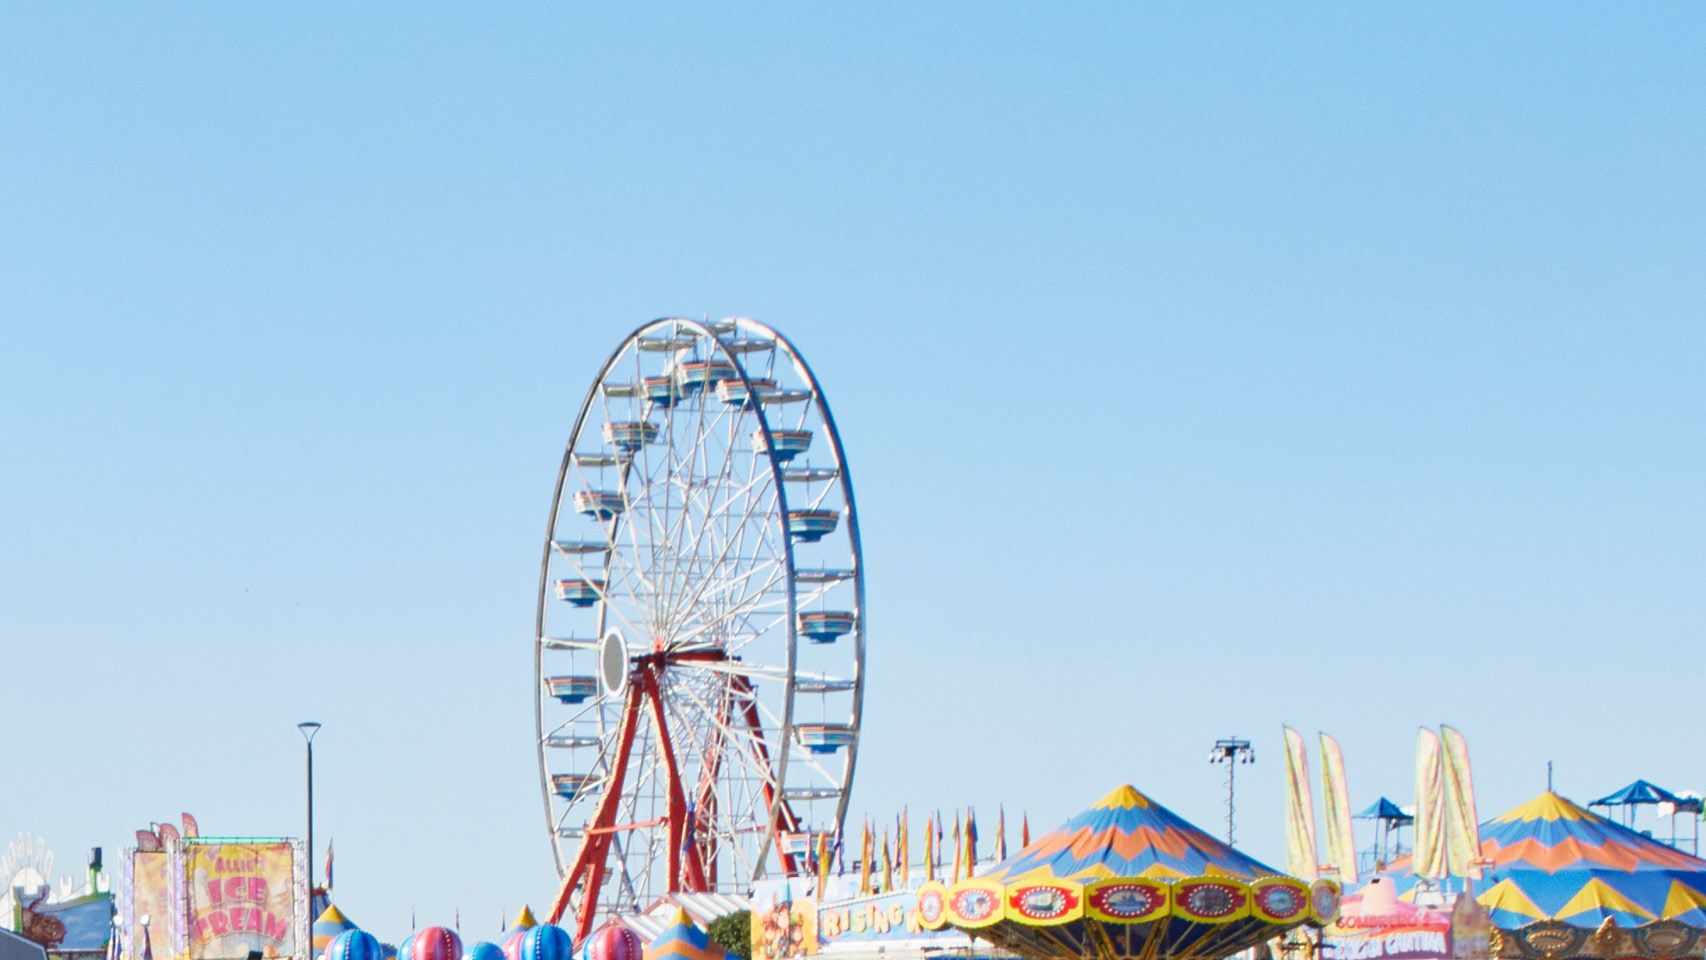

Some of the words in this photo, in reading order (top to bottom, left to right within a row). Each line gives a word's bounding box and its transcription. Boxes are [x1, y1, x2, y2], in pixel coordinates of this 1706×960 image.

[208, 875, 268, 903] ICE
[193, 906, 288, 943] CREAM
[822, 904, 903, 938] RISING
